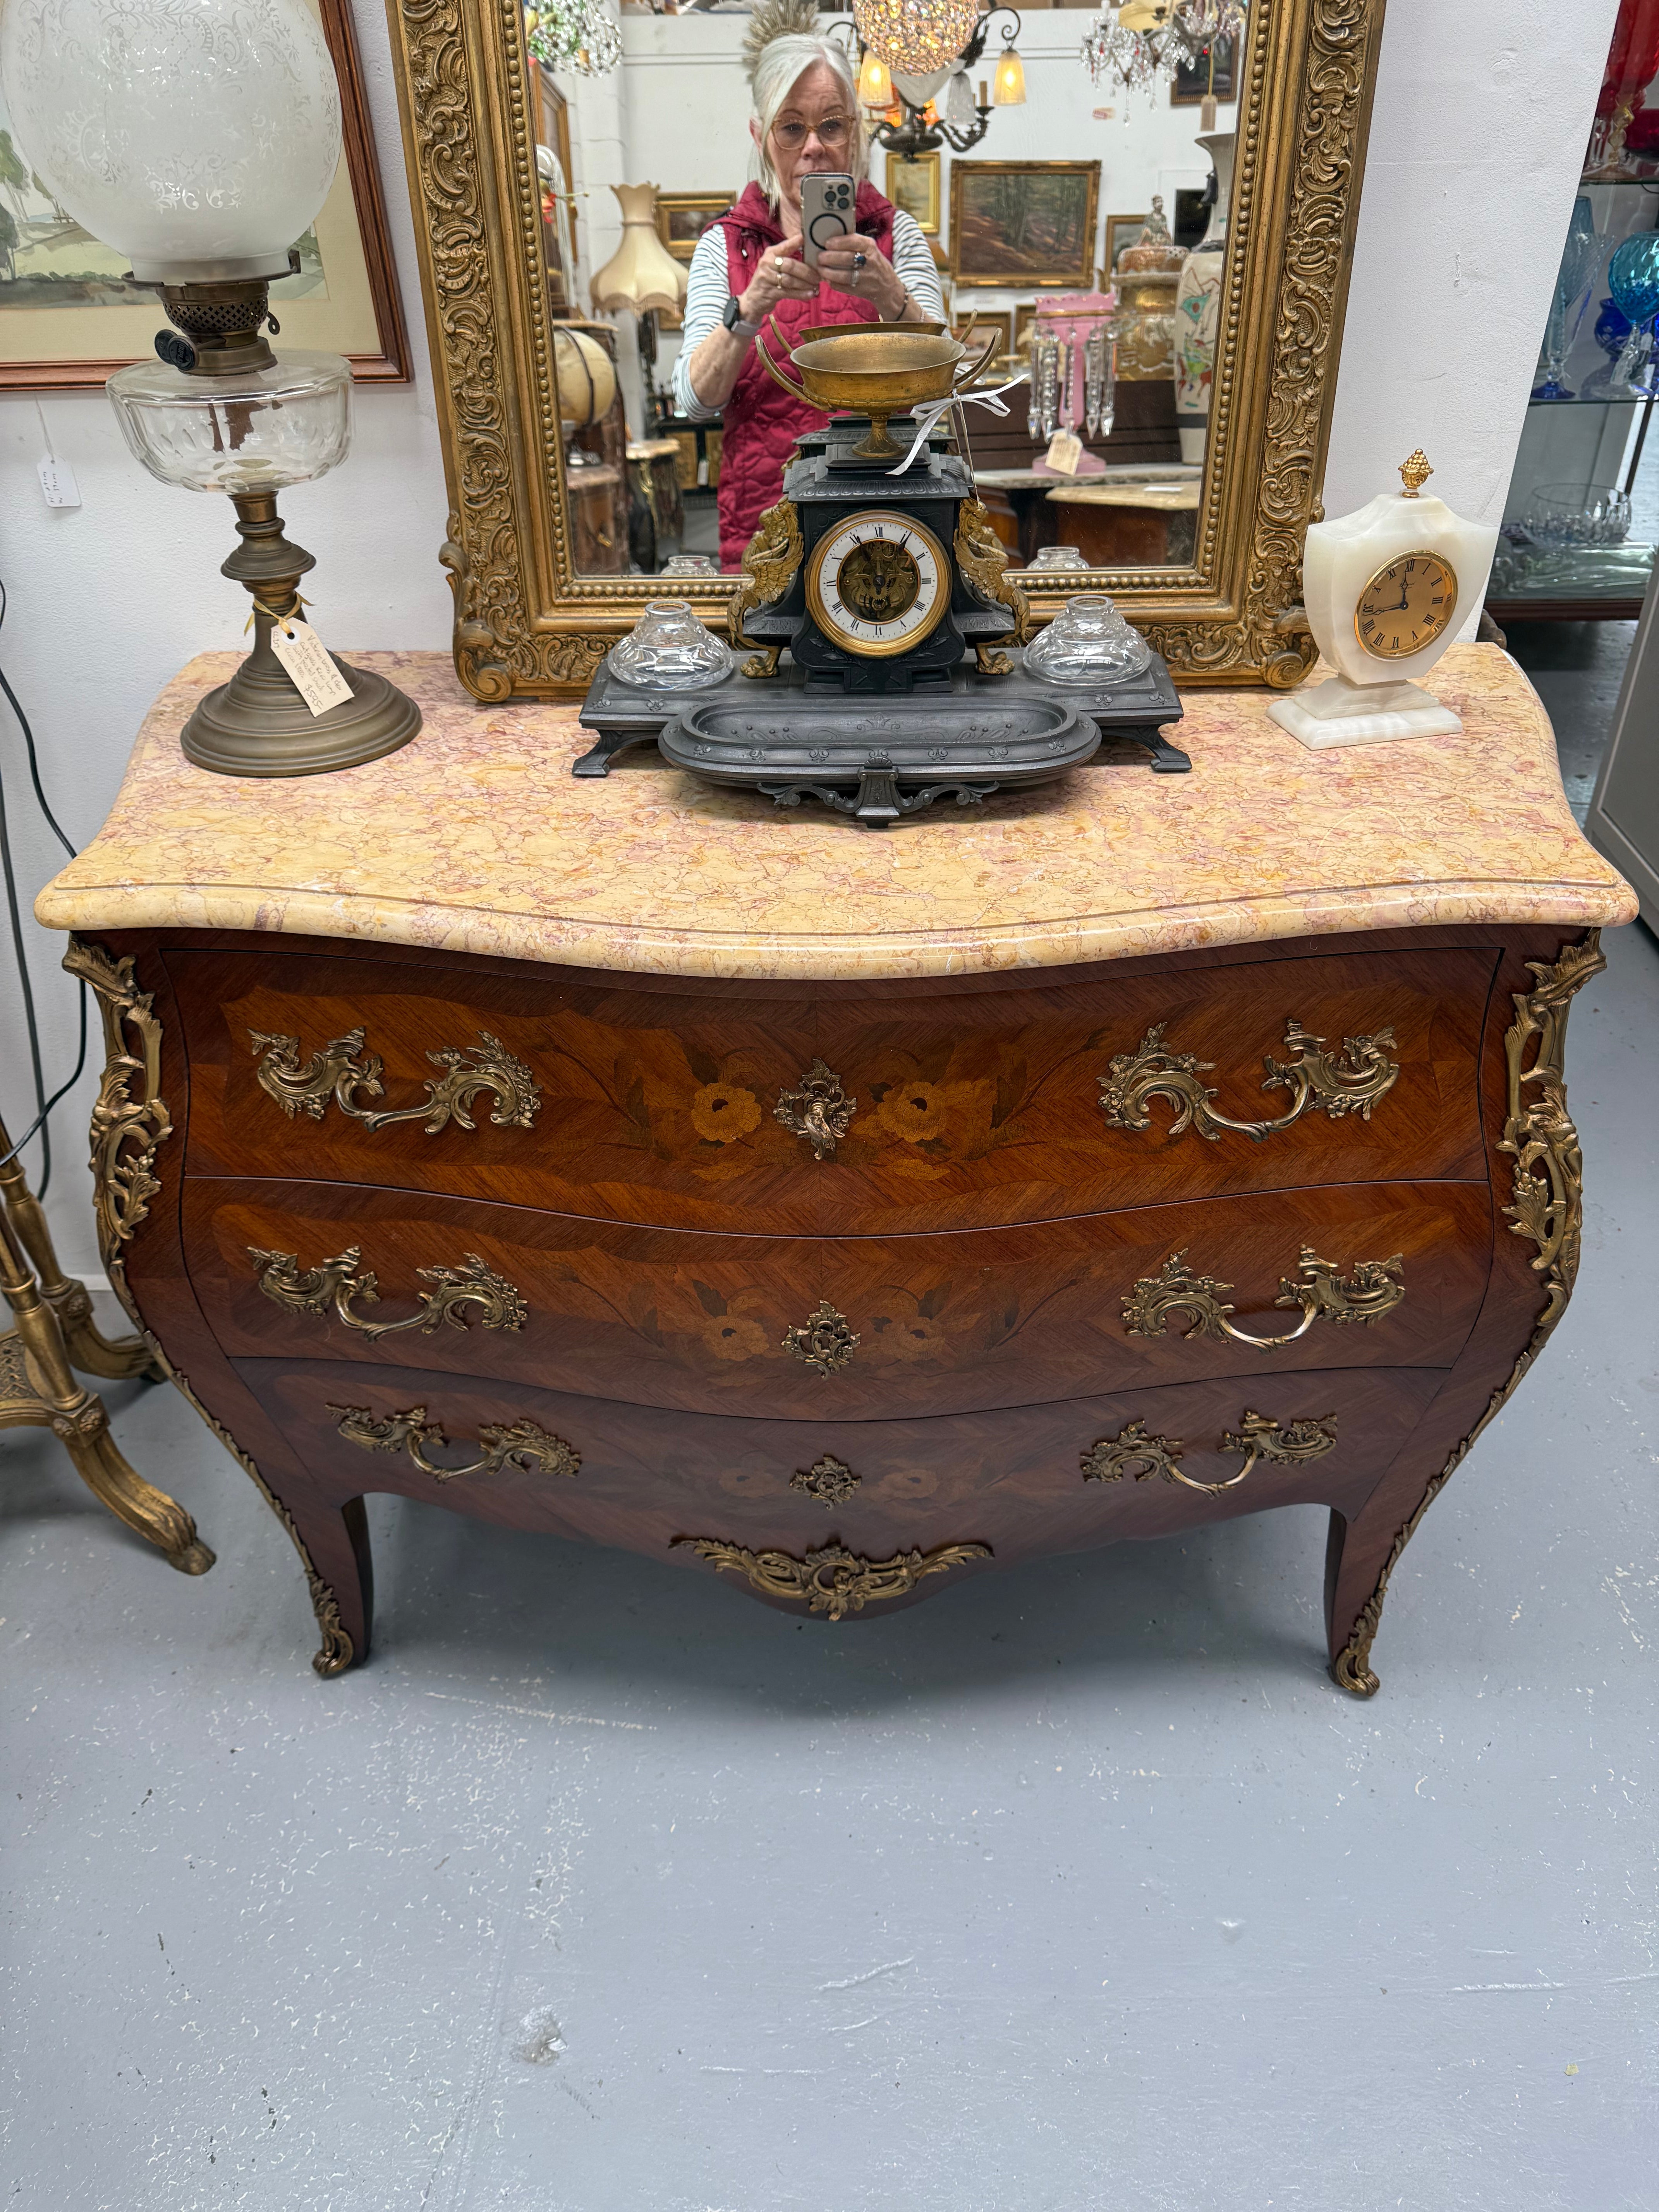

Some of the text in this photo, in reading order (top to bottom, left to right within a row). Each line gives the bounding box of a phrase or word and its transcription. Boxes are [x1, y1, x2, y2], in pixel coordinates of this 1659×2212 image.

[874, 527, 883, 538] XII
[831, 553, 842, 564] X
[915, 552, 926, 561] II
[1403, 559, 1415, 572] XII
[1422, 563, 1431, 575] I
[1386, 568, 1396, 580] XI
[1431, 576, 1443, 587] II
[1372, 585, 1382, 594] X
[914, 600, 926, 611] IIII
[1431, 596, 1444, 605] III
[832, 601, 843, 614] VIII
[1363, 604, 1374, 613] IX
[850, 618, 860, 630] VII
[900, 620, 907, 630] V
[1422, 613, 1436, 627] IIII
[875, 625, 882, 635] VI
[1362, 618, 1376, 635] VIII
[1373, 632, 1385, 646] VII
[1412, 630, 1418, 642] V
[1391, 636, 1399, 649] VI
